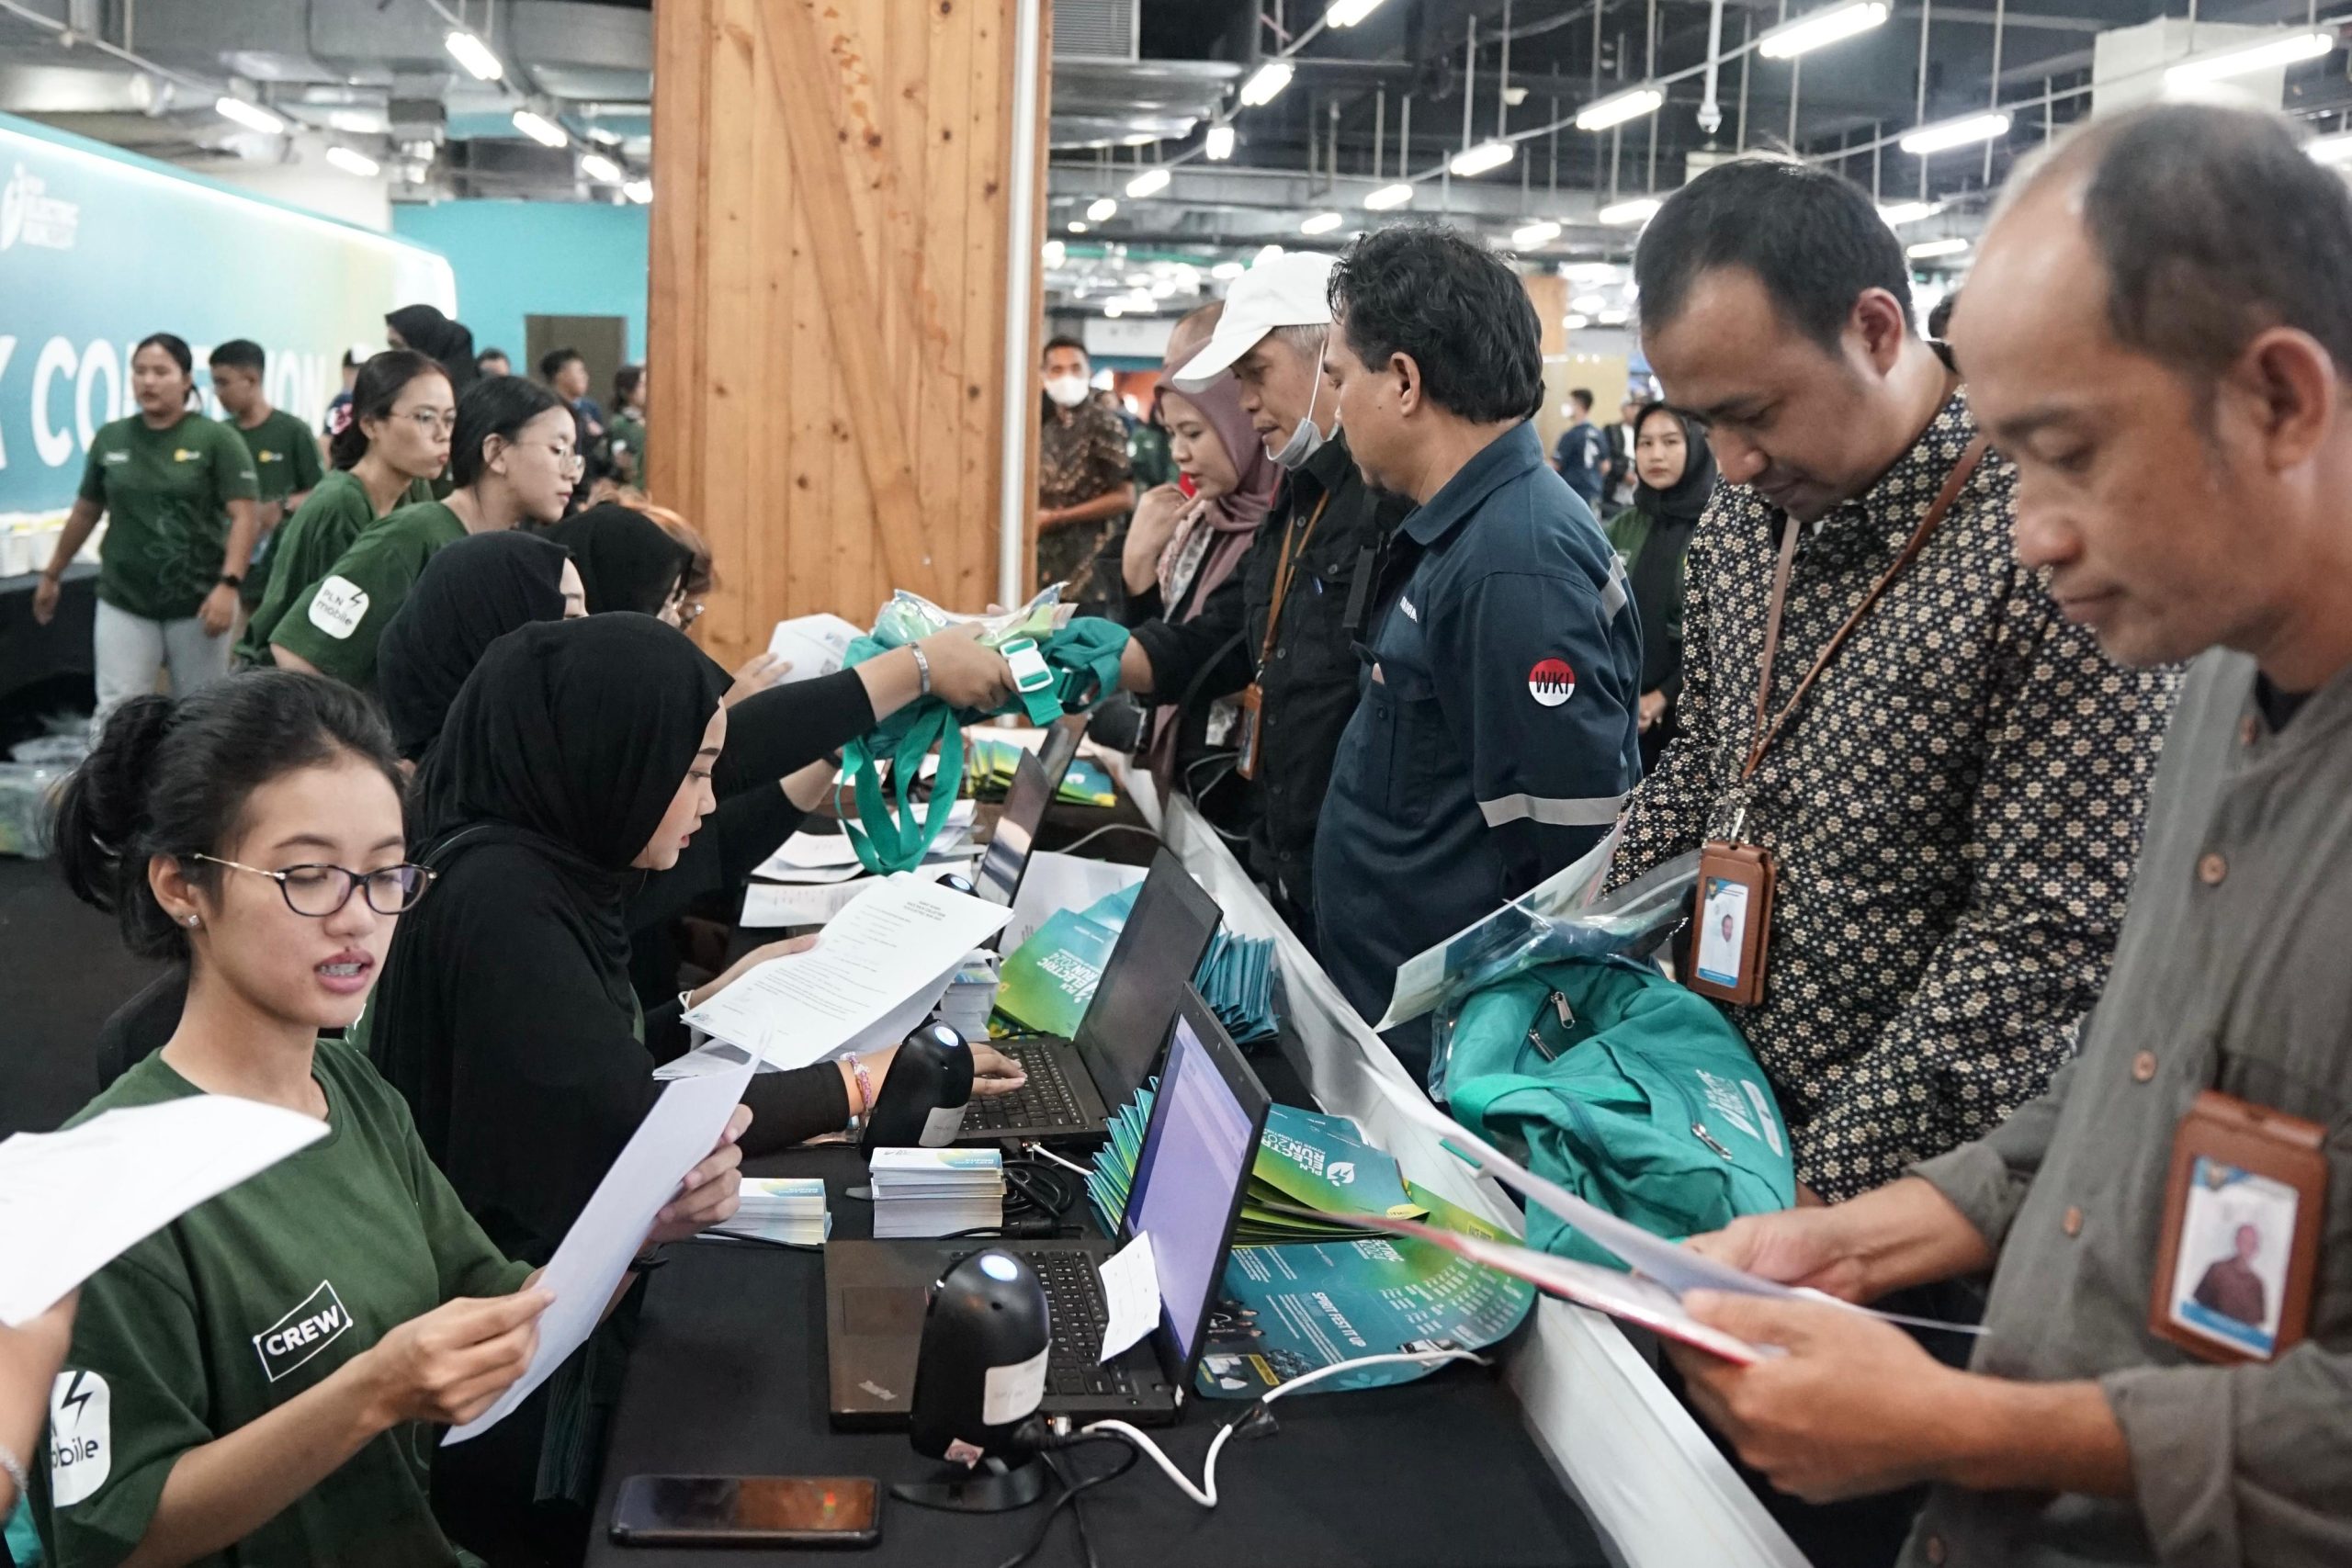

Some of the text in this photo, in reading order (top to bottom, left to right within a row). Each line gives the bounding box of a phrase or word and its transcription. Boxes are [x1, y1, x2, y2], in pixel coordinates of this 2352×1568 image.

[322, 589, 345, 606] PLN
[316, 601, 352, 626] mobile
[1535, 671, 1569, 694] WKI
[1036, 957, 1088, 989] ELECTRIC
[1071, 964, 1098, 981] RUN
[1261, 1138, 1324, 1171] ELECTR
[1289, 1142, 1326, 1161] RUN
[1299, 1163, 1323, 1177] PLN
[266, 1304, 340, 1356] CREW
[1312, 1292, 1339, 1313] SPIRIT
[1329, 1313, 1352, 1329] FEST
[1349, 1336, 1367, 1348] UP
[51, 1437, 98, 1469] obile
